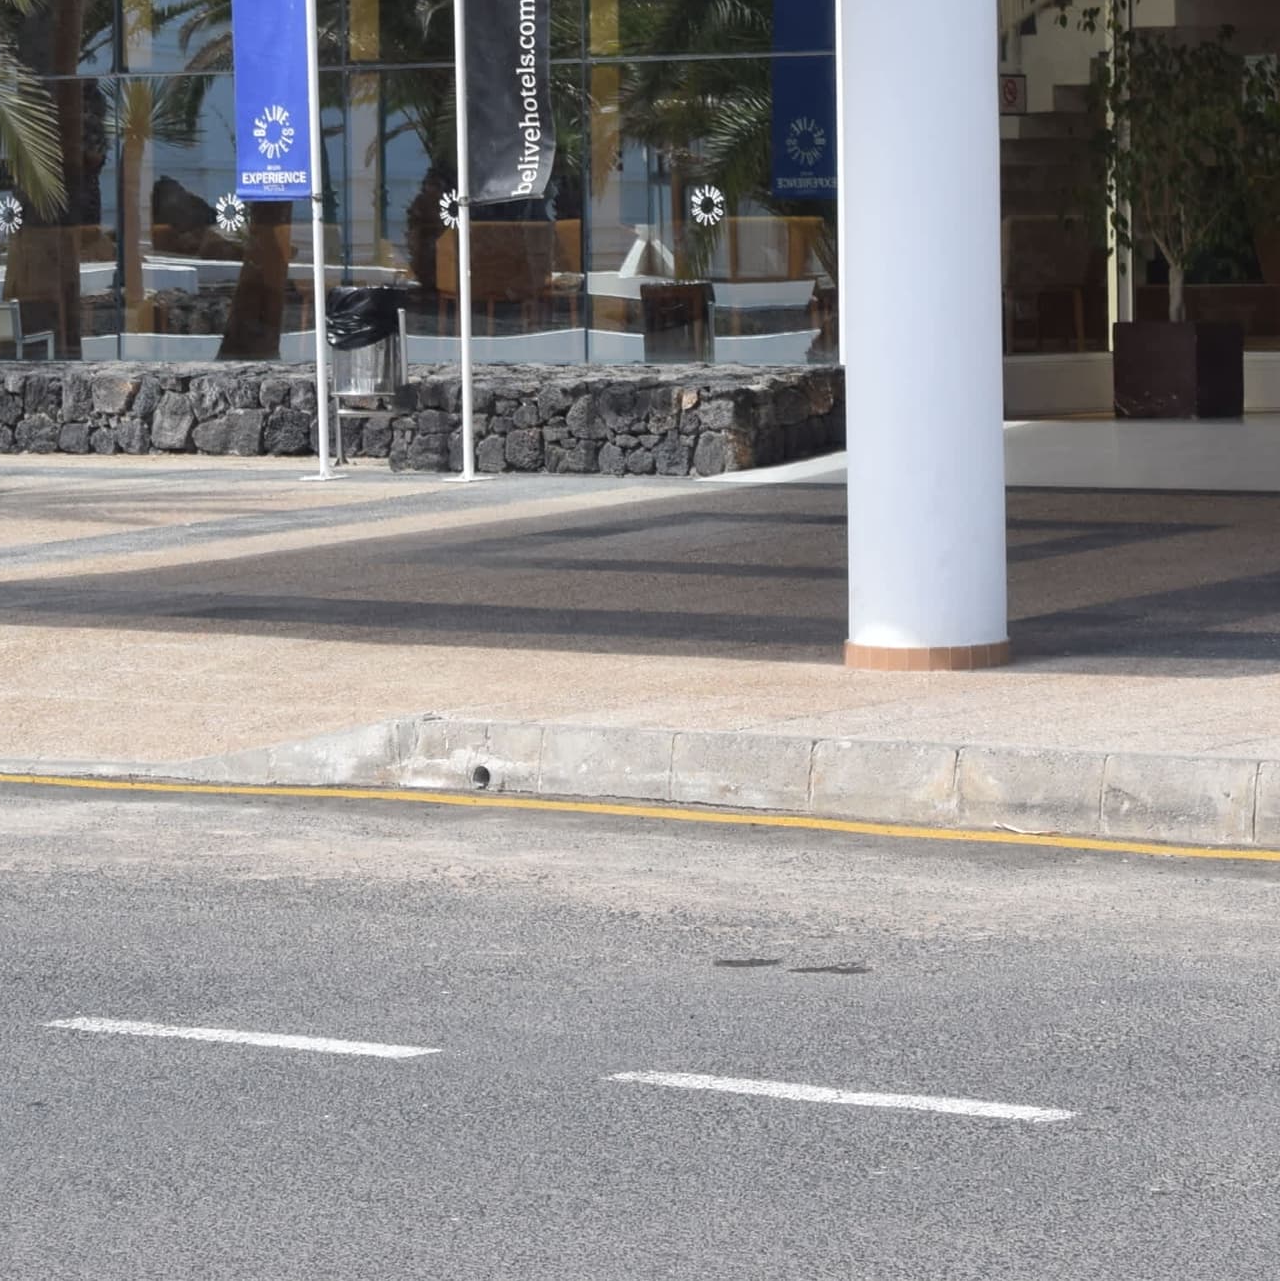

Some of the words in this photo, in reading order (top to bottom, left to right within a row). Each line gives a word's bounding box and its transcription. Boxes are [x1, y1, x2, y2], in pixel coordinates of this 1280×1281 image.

[253, 118, 268, 137] BE
[264, 104, 289, 125] LIVE
[258, 128, 295, 159] HOTELS
[242, 171, 307, 184] EXPERIENCE
